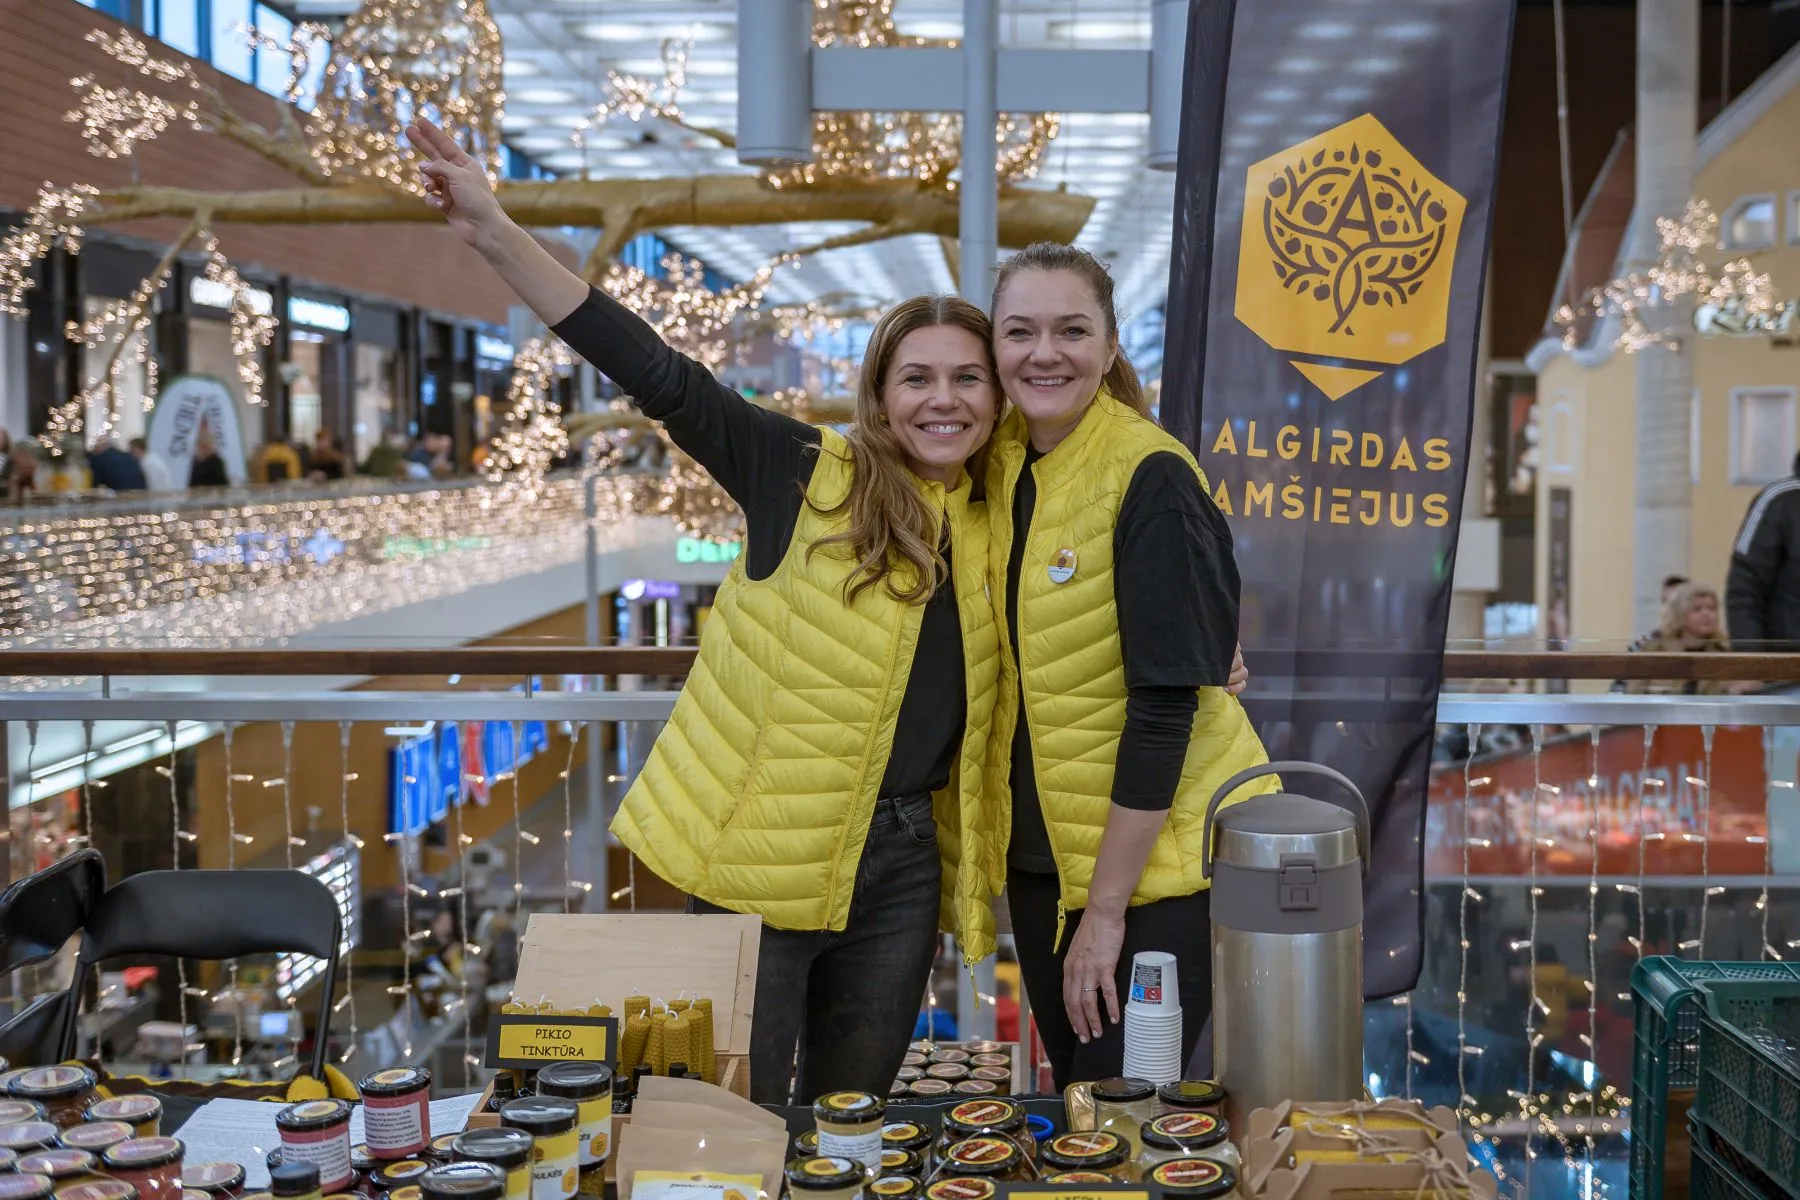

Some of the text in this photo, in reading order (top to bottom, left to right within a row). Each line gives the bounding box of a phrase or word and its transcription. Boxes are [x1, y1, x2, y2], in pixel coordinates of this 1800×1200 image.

[1212, 417, 1451, 472] ALGIRDAS
[1213, 475, 1449, 527] AMŠIEJUS
[535, 1028, 572, 1040] PIKIO
[520, 1044, 585, 1057] TINKTŪRA
